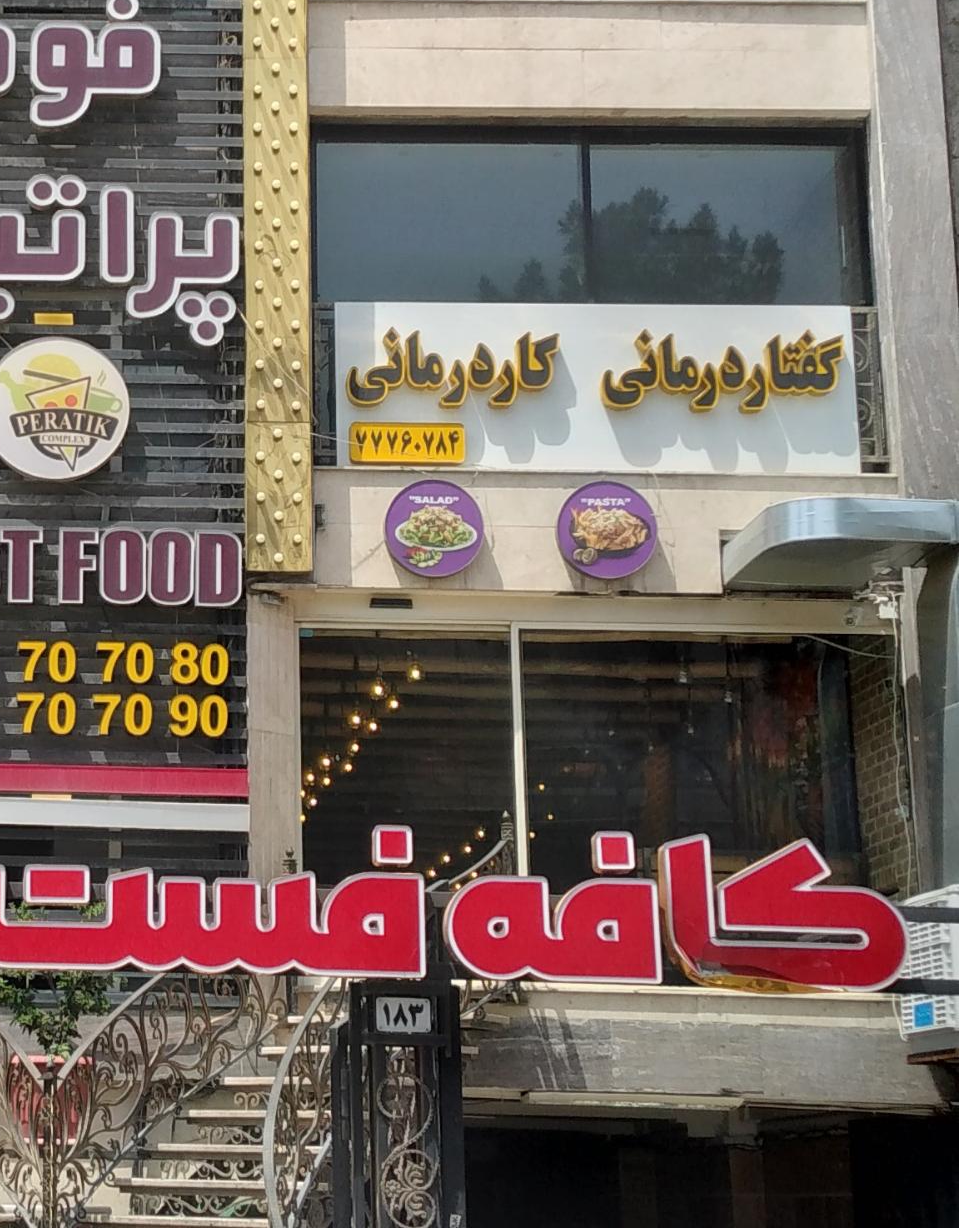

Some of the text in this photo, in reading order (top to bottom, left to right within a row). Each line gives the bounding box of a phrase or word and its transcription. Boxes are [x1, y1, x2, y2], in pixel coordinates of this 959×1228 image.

[15, 411, 112, 438] PERATIK
[41, 434, 86, 444] COMPLEX
[355, 429, 460, 456] ۷۷۷۶۰۷۸۴
[59, 527, 242, 607] FOOD
[17, 640, 78, 684] 70
[96, 640, 155, 685] 70
[170, 641, 229, 686] 80
[16, 691, 78, 735] 70
[92, 692, 154, 736] 70
[169, 693, 229, 738] 90
[443, 830, 910, 992] کافه
[383, 1002, 424, 1027] ۱۸۳
